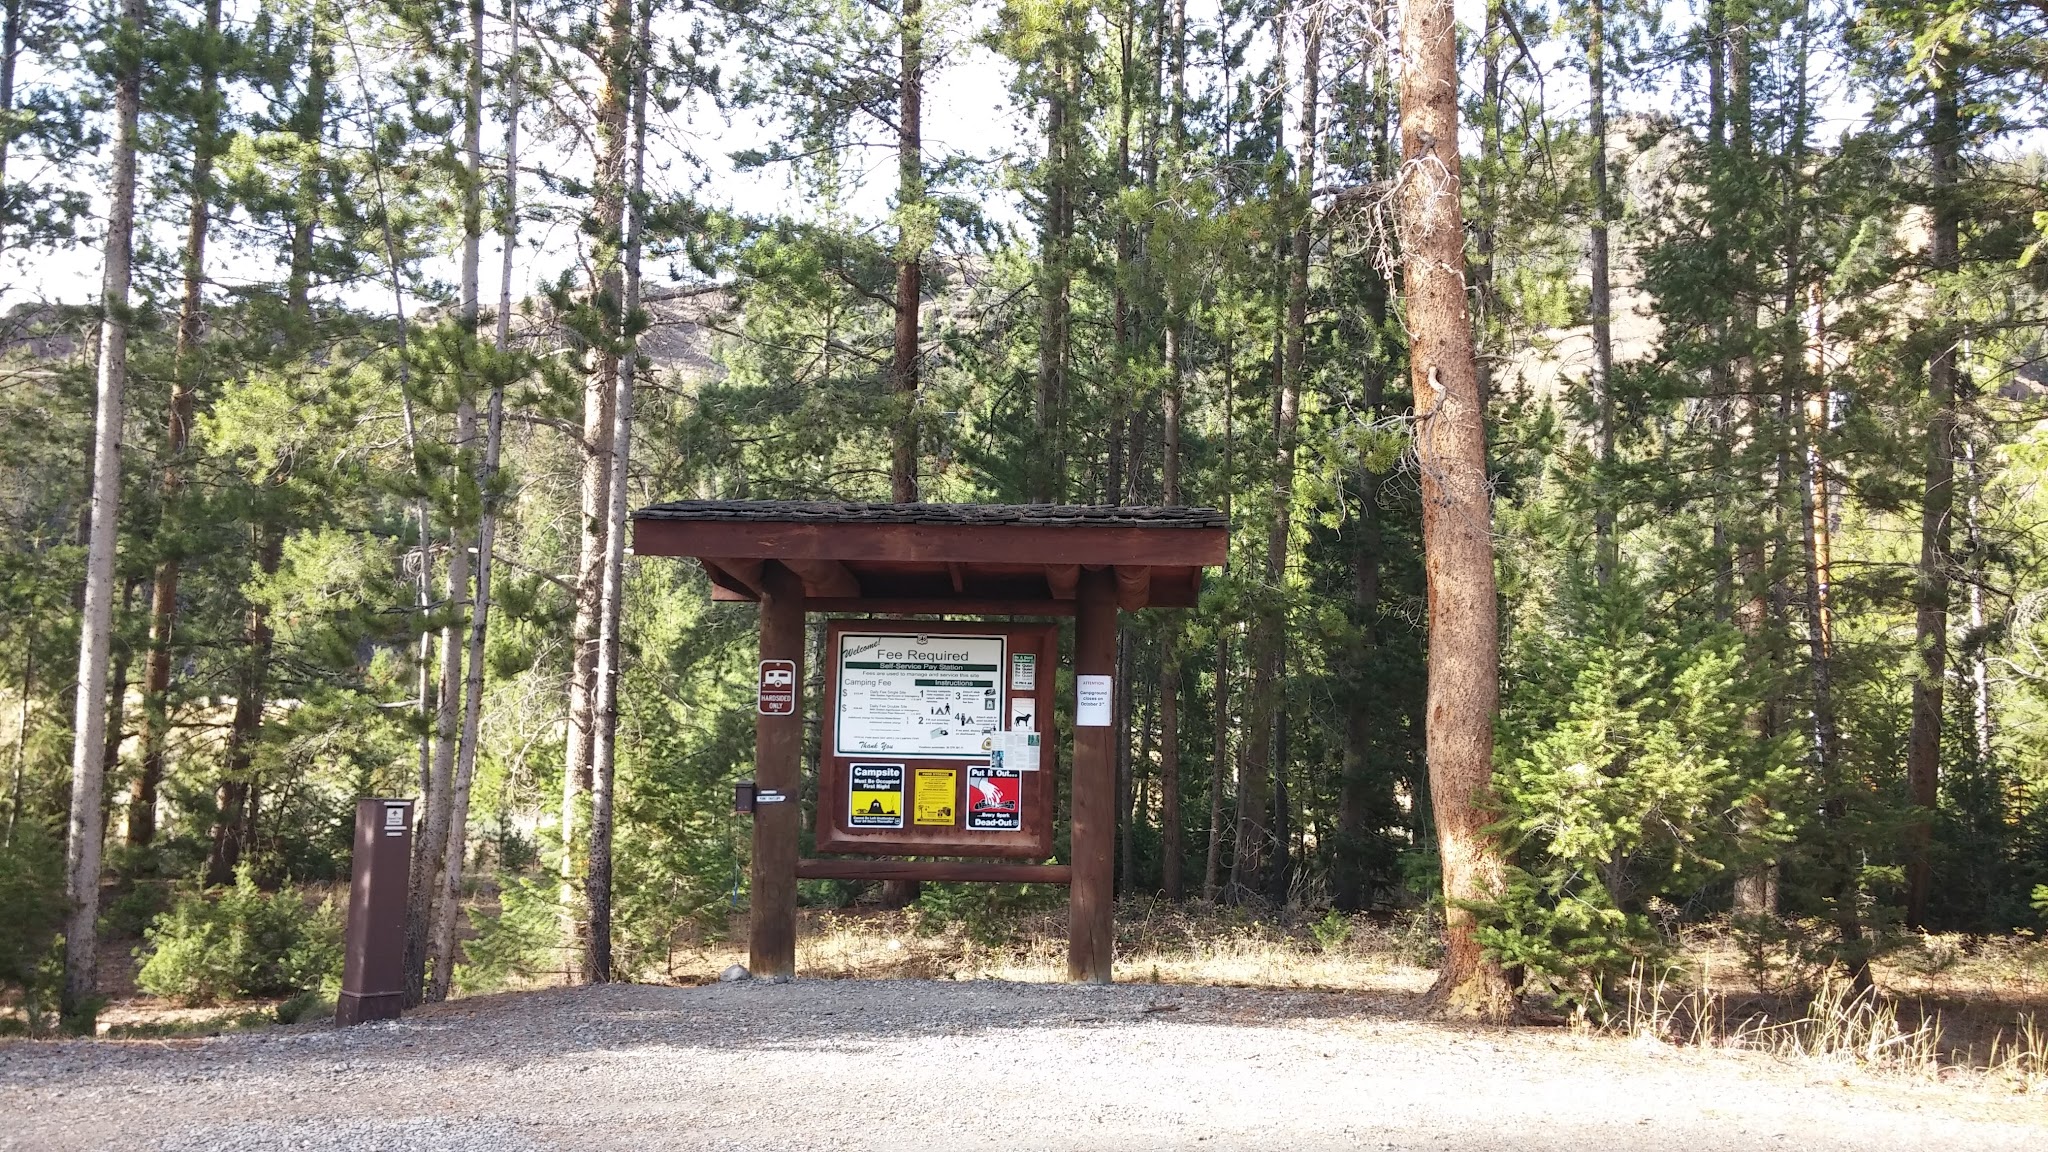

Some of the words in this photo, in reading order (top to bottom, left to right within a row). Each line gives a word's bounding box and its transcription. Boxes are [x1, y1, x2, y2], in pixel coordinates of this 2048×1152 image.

[842, 637, 881, 658] Welcome!
[877, 649, 903, 660] Fee
[908, 650, 969, 663] Required
[880, 662, 922, 670] Self-Service
[923, 663, 938, 671] Pay
[844, 678, 877, 687] Camping
[761, 694, 792, 702] HARDSIDED
[919, 690, 924, 698] 1
[955, 692, 961, 700] 3
[769, 702, 783, 710] ONLY
[918, 716, 924, 725] 2
[954, 712, 960, 721] 4
[859, 741, 878, 749] Thank
[880, 741, 894, 751] You
[854, 767, 900, 778] Campsite
[971, 769, 985, 777] Put
[987, 769, 993, 777] It
[975, 818, 1012, 826] Dead-Out
